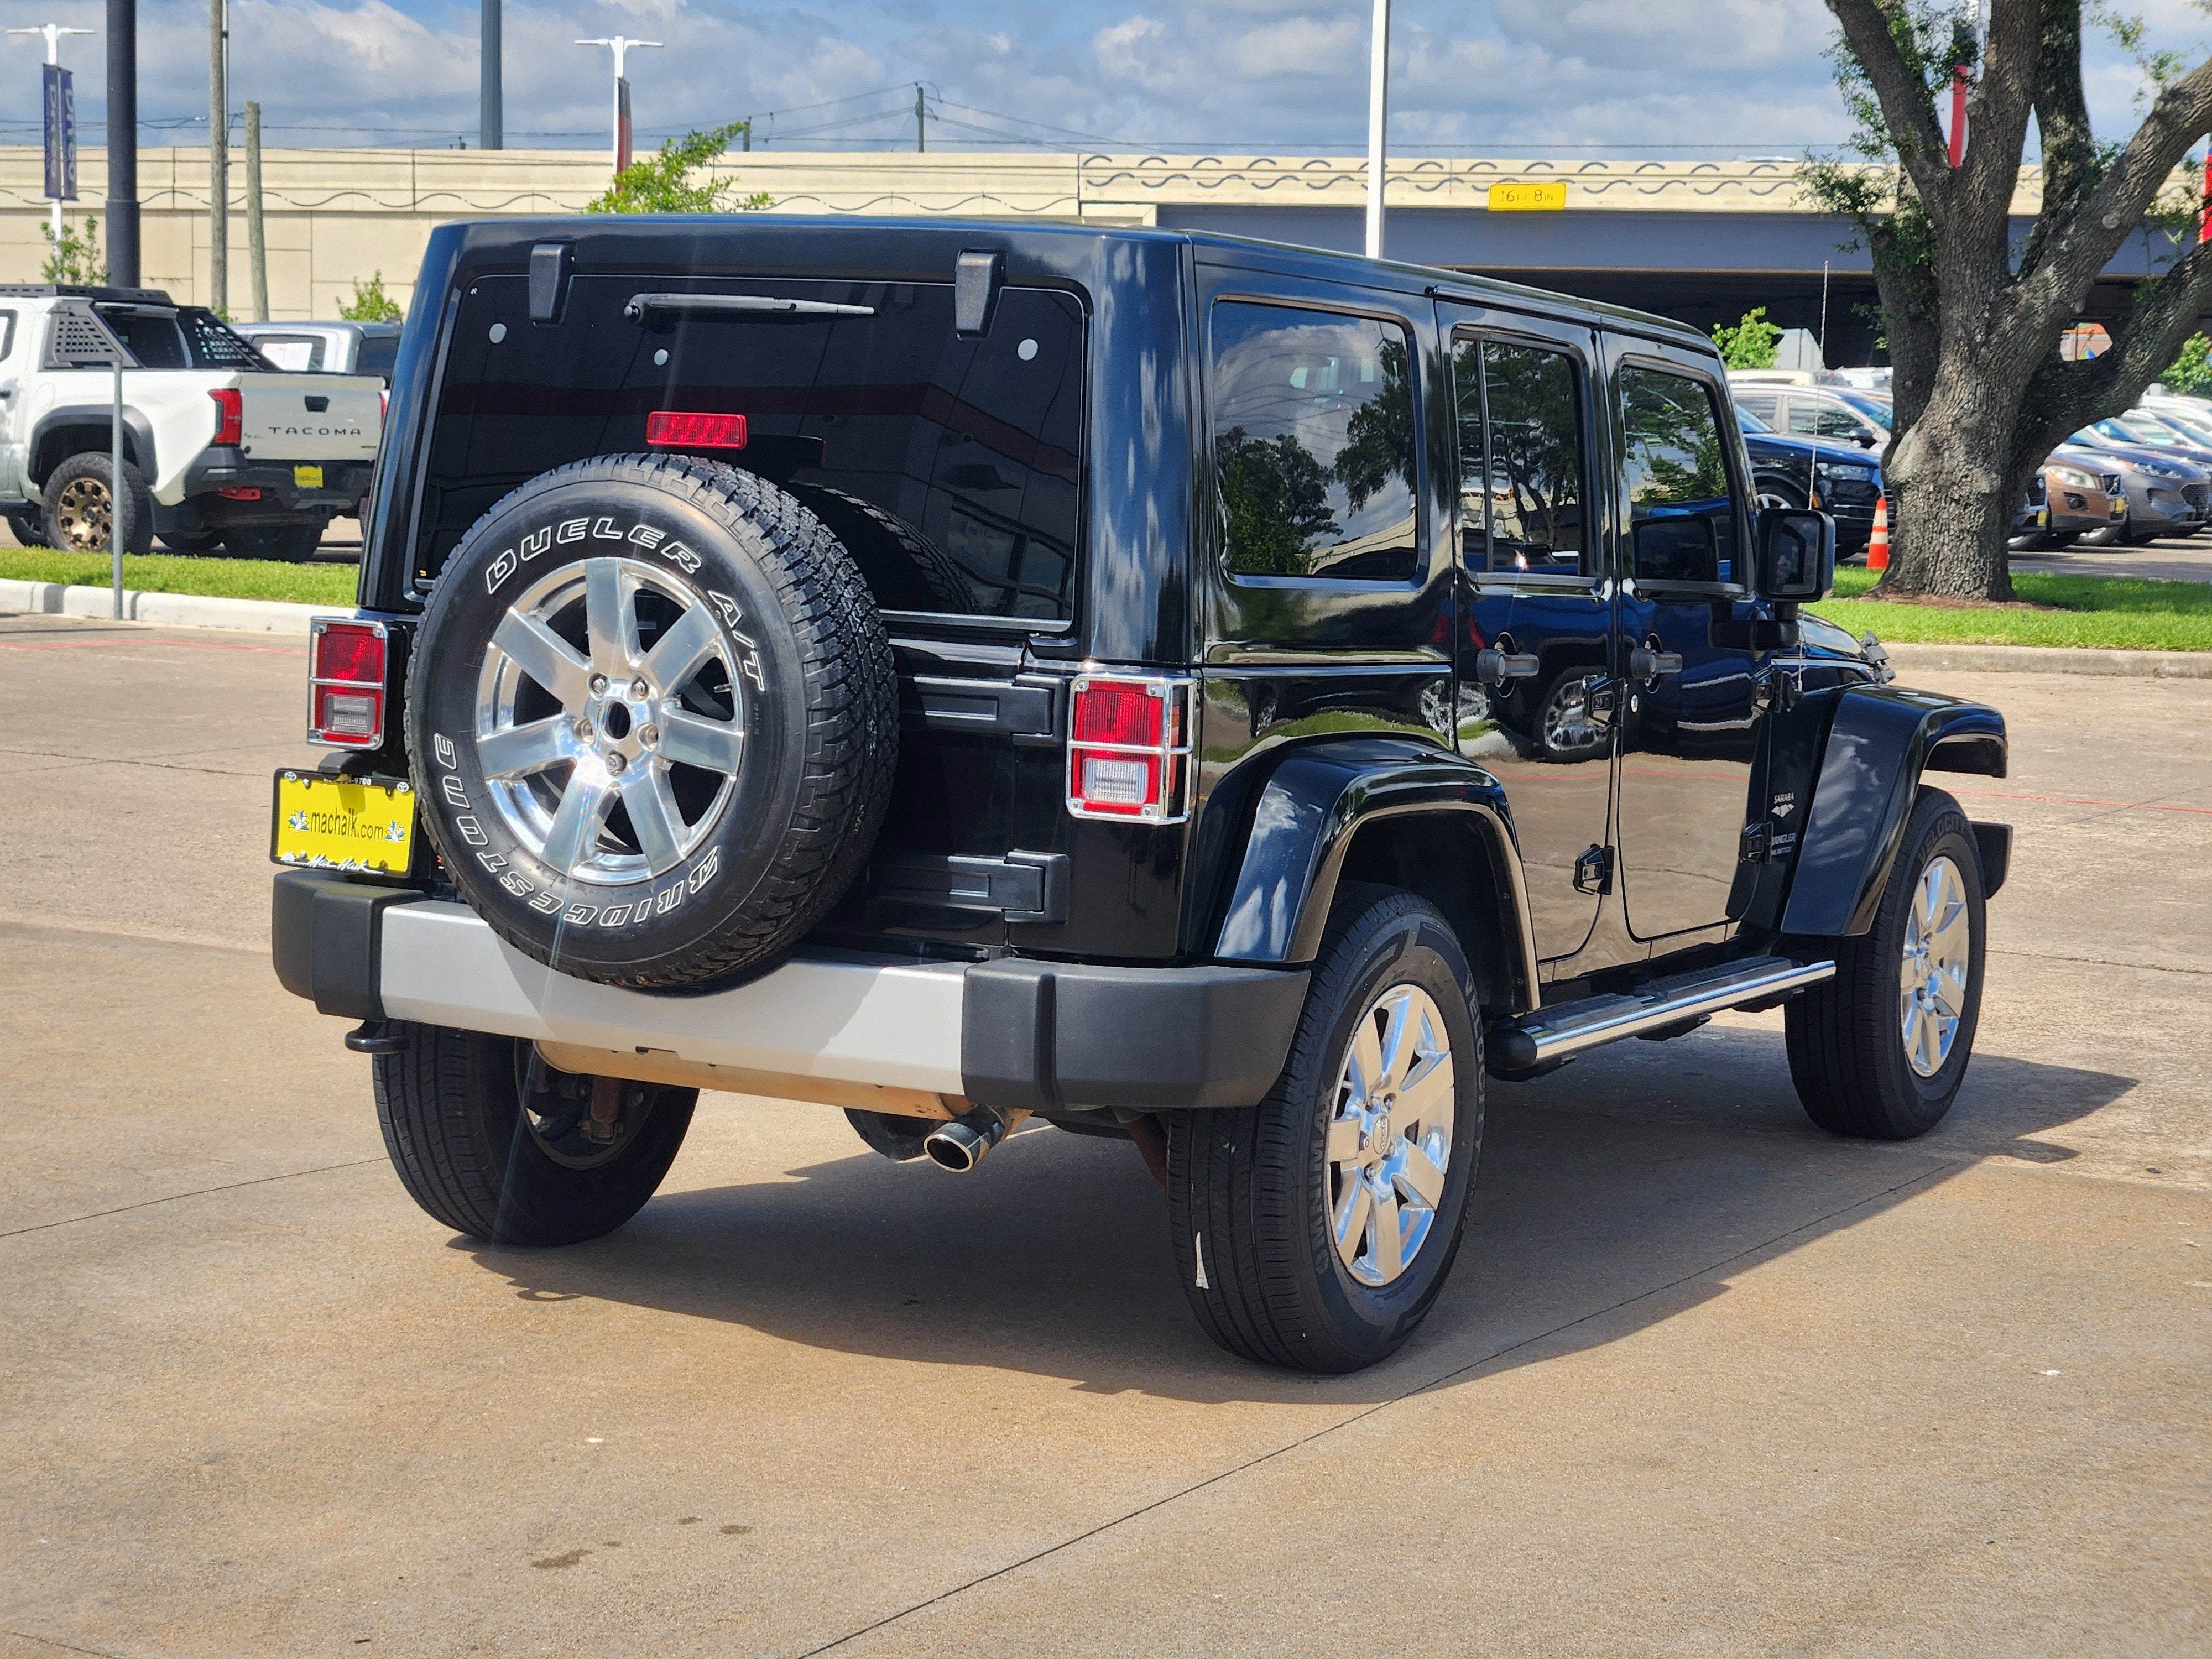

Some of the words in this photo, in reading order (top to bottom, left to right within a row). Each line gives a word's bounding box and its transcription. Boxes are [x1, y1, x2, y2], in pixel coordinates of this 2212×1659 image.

[1501, 190, 1515, 202] 16
[1534, 190, 1542, 202] 8
[268, 427, 361, 435] TACOMA
[485, 517, 702, 596] DUELER
[707, 589, 766, 693] A/T
[1773, 792, 1794, 804] SAHARA
[311, 807, 383, 840] machaik.com
[434, 733, 719, 927] BRIDGESTONE
[1917, 813, 1965, 864] VELOCITY
[306, 854, 337, 869] Mac
[337, 858, 382, 874] Haik
